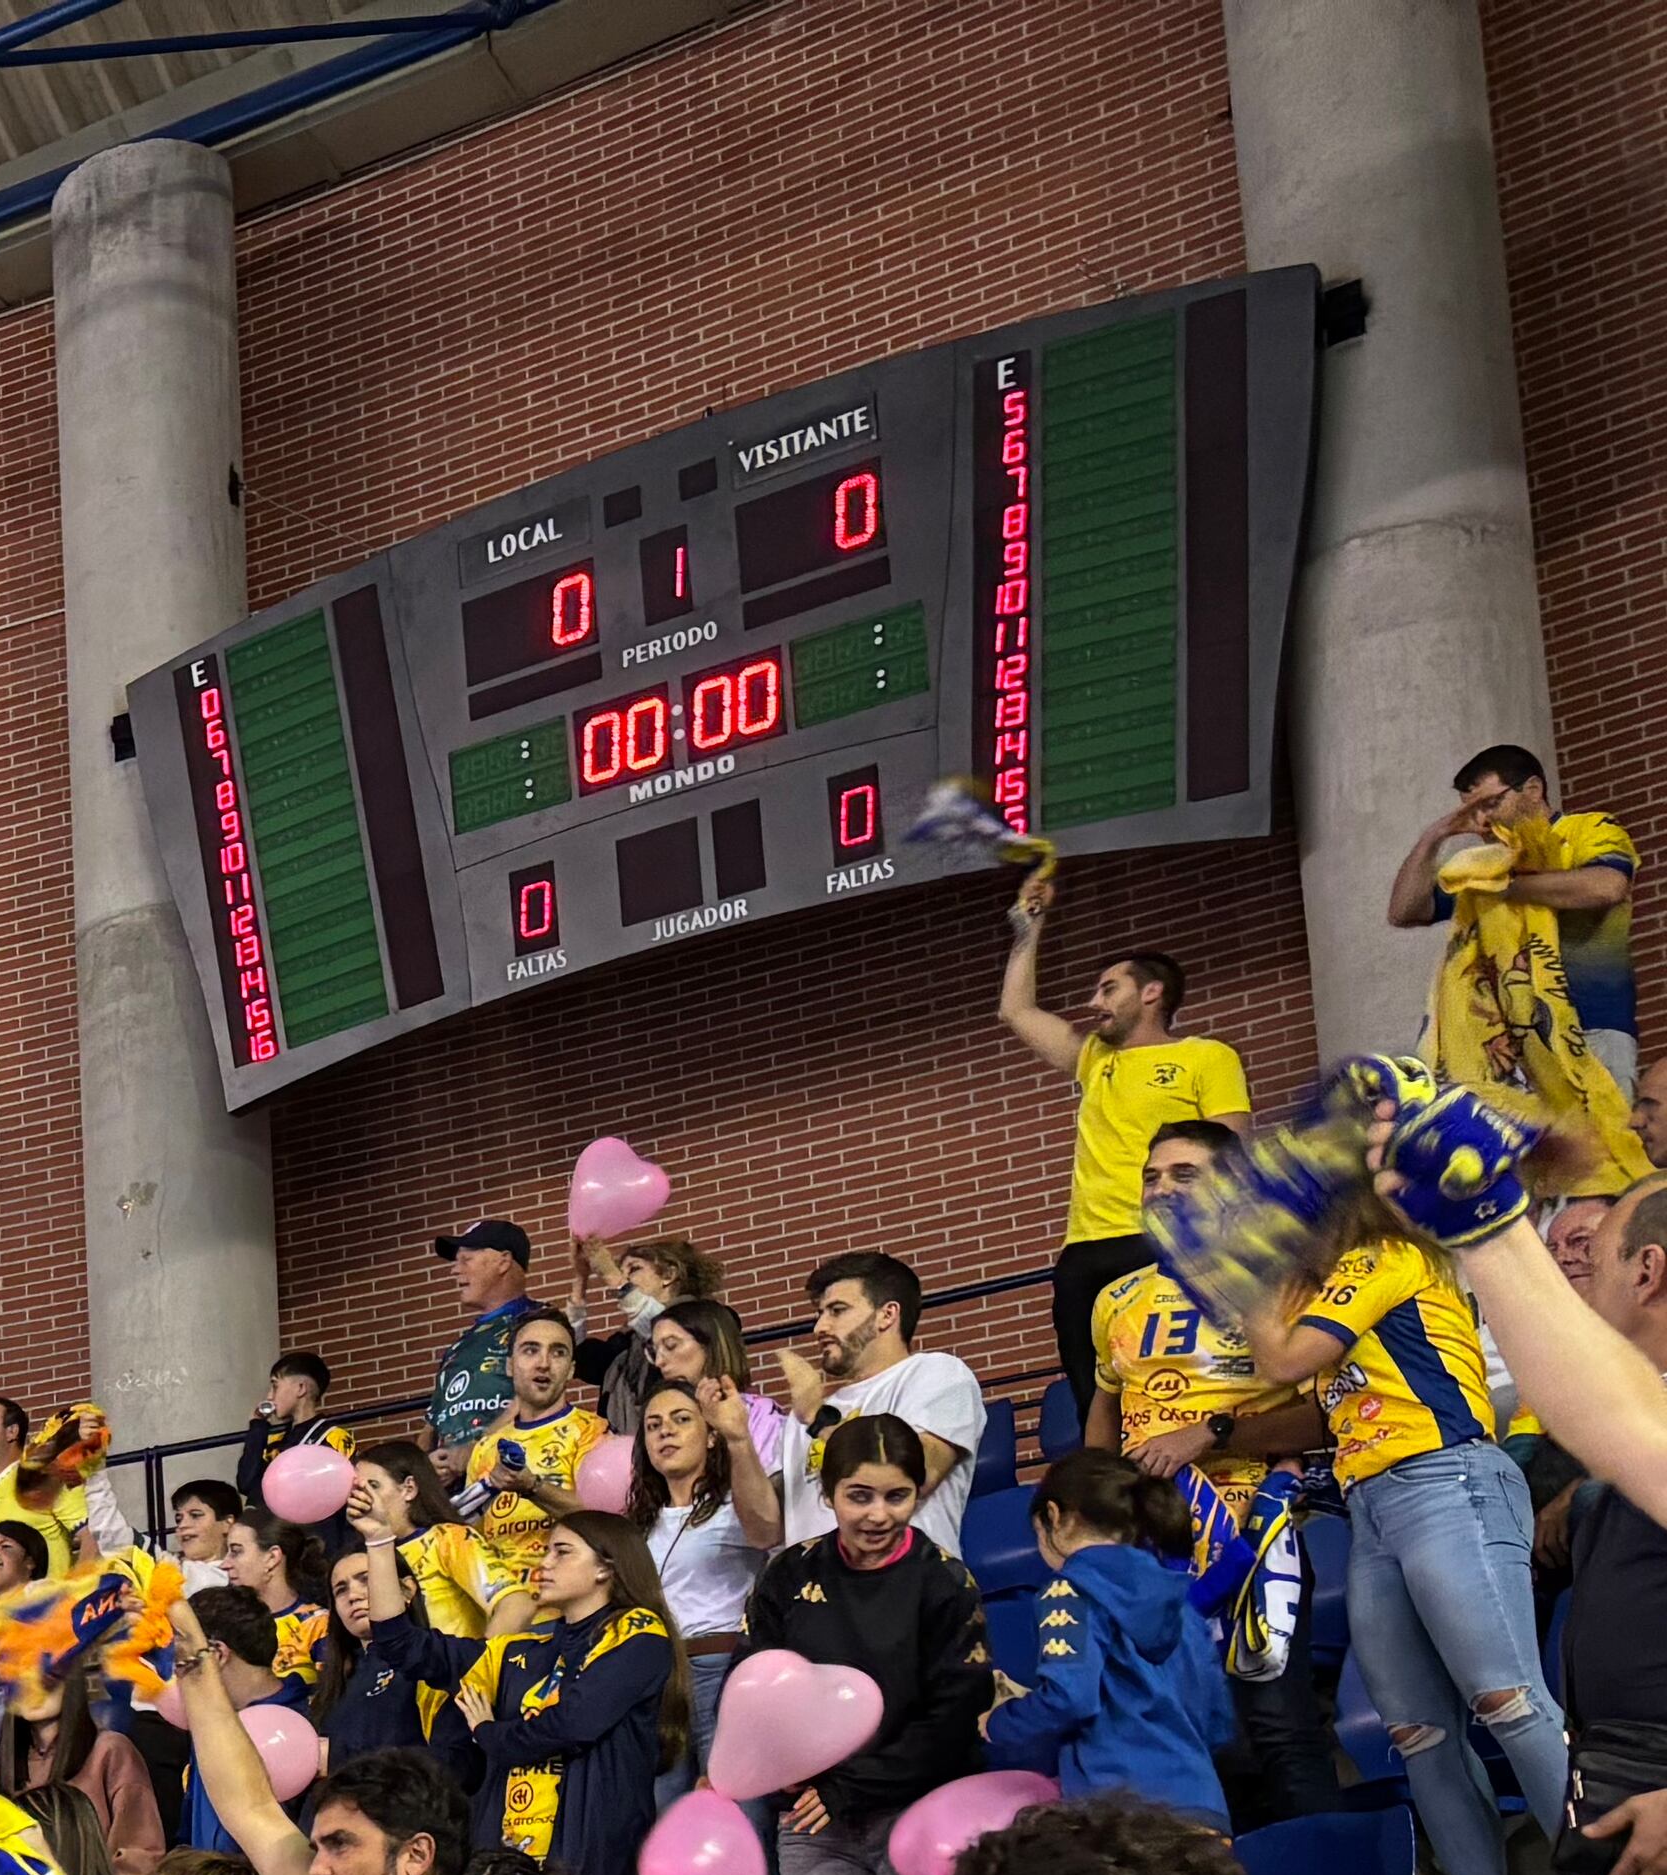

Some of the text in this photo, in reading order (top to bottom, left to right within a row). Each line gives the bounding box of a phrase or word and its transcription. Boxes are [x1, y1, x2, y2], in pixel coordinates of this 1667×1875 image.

[997, 357, 1016, 390] E
[1003, 391, 1026, 426] 5
[738, 407, 870, 472] VISITANTE
[1002, 429, 1027, 464] 6
[1006, 467, 1028, 498] 7
[834, 472, 877, 551] 0
[1002, 503, 1027, 539] 8
[486, 518, 562, 564] LOCAL
[1003, 541, 1027, 576] 9
[675, 547, 685, 597] 1
[552, 572, 592, 646] 0
[995, 579, 1028, 615] 10
[622, 621, 718, 669] PERIODO
[995, 617, 1028, 652] 11
[191, 660, 208, 687] E
[995, 655, 1028, 690] 12
[582, 661, 778, 784] 00:00
[995, 693, 1028, 728] 13
[206, 720, 226, 749] 6
[995, 730, 1028, 765] 14
[212, 750, 231, 775] 7
[629, 755, 736, 803] MONDO
[216, 780, 236, 810] 8
[994, 766, 1027, 803] 15
[221, 810, 241, 840] 9
[839, 785, 875, 846] 0
[220, 842, 245, 874] 10
[225, 874, 250, 904] 11
[826, 859, 895, 894] FALTAS
[231, 905, 255, 936] 12
[520, 880, 551, 938] 0
[651, 899, 748, 942] JUGADOR
[236, 936, 260, 967] 13
[507, 950, 568, 982] FALTAS
[241, 967, 265, 999] 14
[246, 998, 270, 1030] 15
[250, 1030, 276, 1062] 16
[498, 1518, 552, 1536] arand
